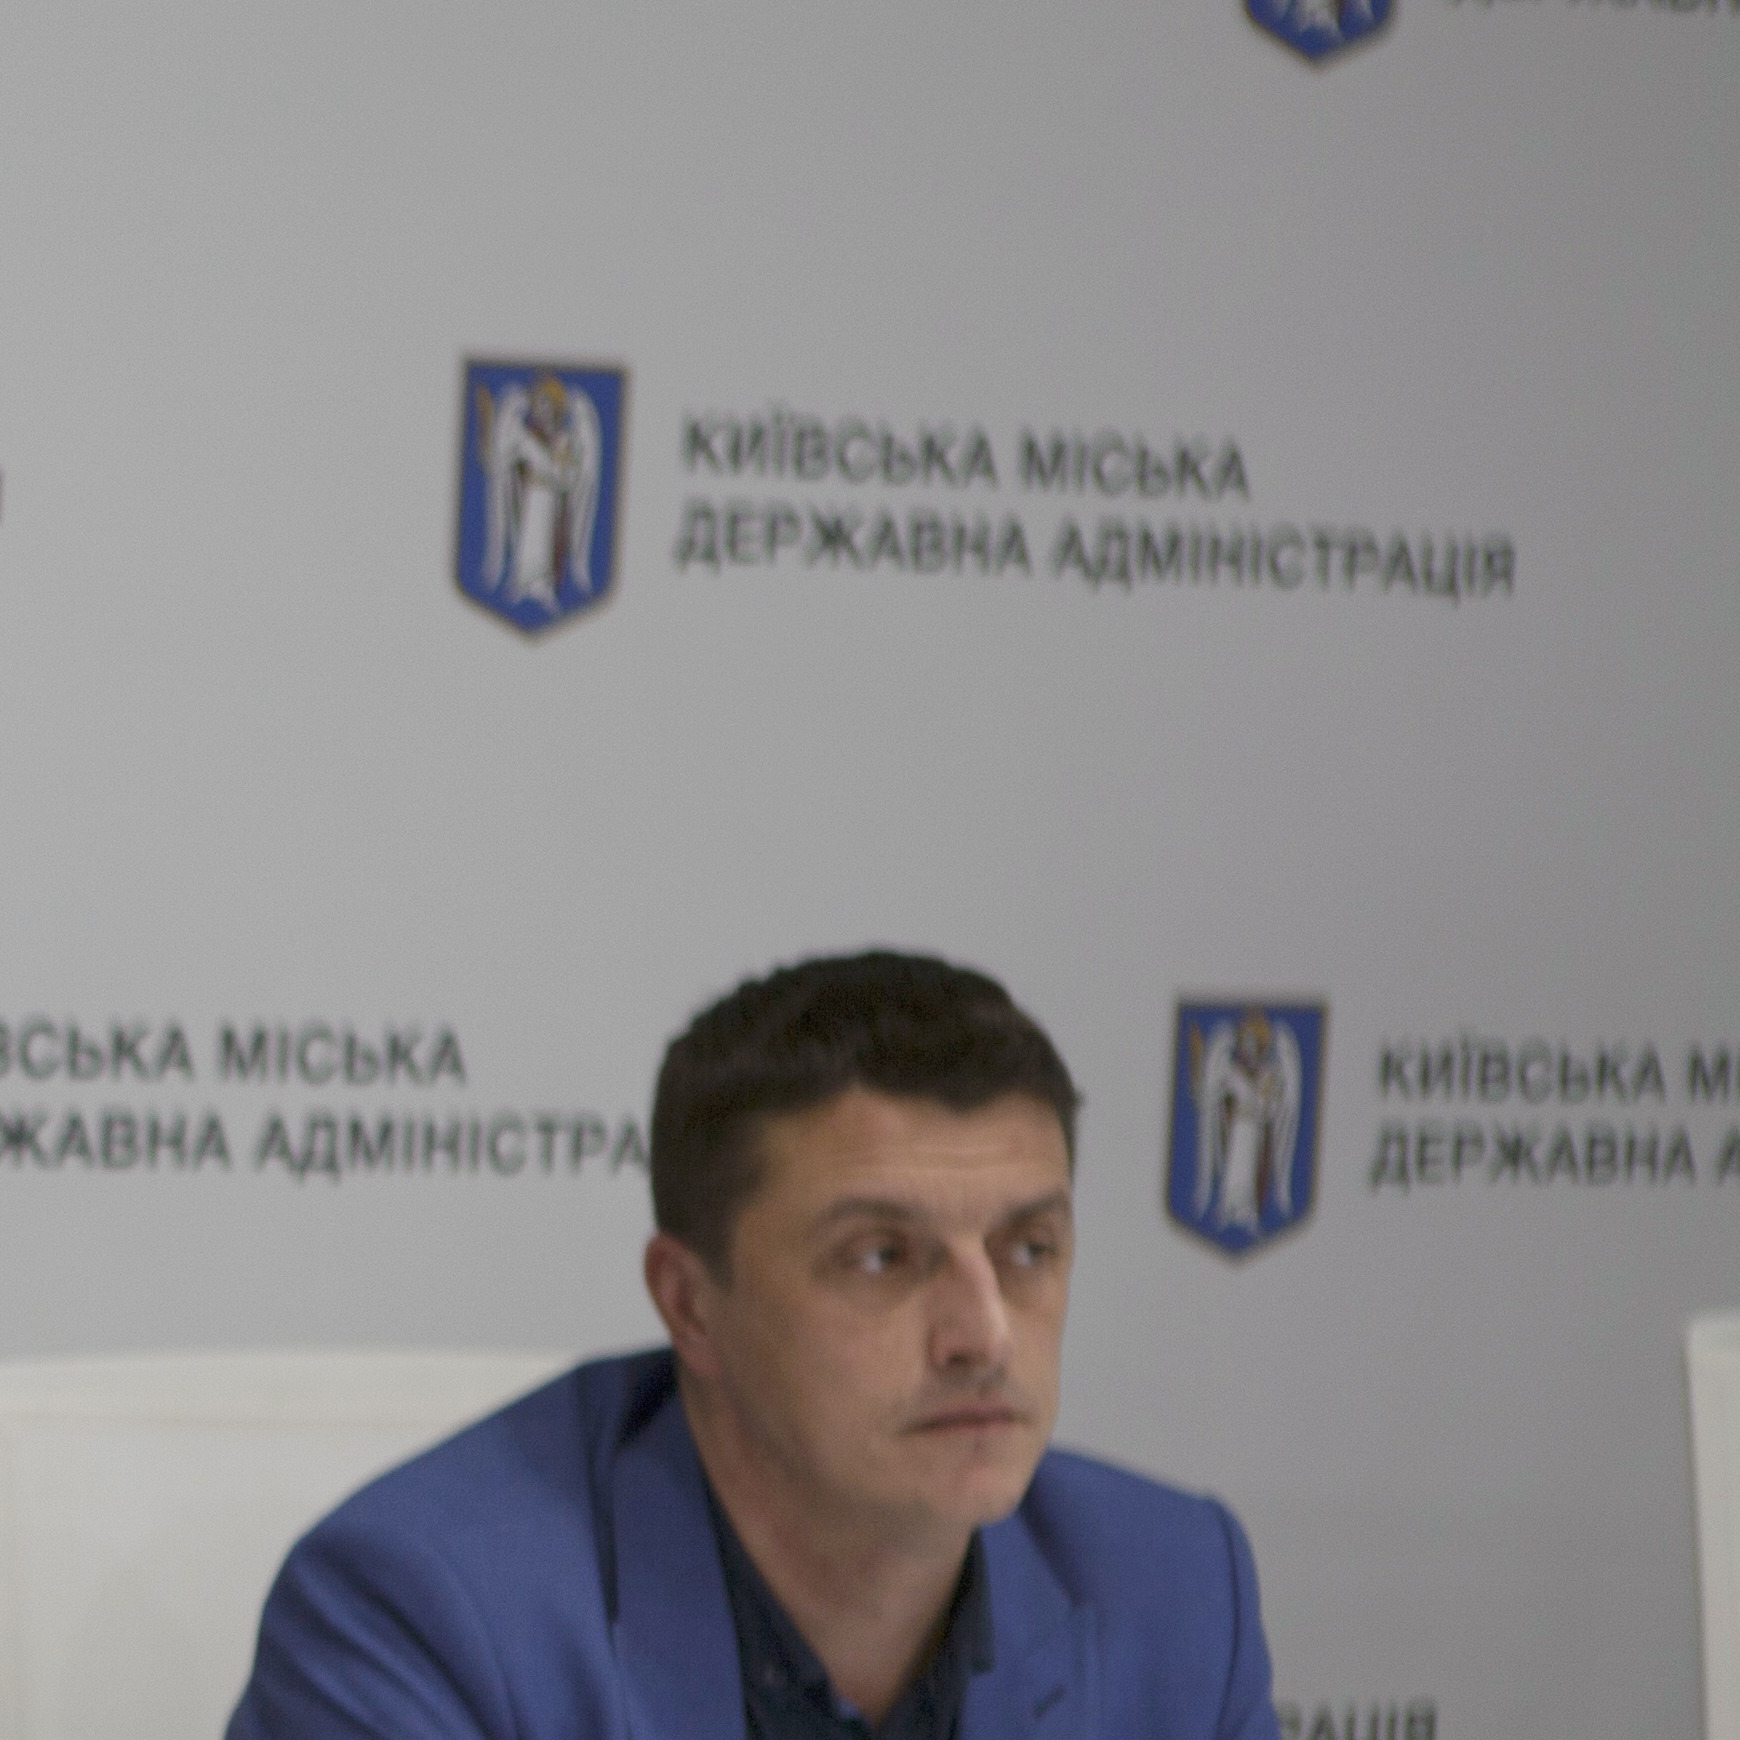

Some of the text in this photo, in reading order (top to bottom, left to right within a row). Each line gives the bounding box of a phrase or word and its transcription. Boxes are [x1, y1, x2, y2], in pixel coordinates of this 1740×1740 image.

[680, 405, 1251, 500] КИЇВСЬКА МІСЬКА
[672, 500, 1518, 607] ДЕРЖАВНА АДМІНІСТРАЦІЯ
[216, 1022, 468, 1088] МІСЬКА
[1376, 1030, 1667, 1104] КИЇВСЬКА
[1367, 1120, 1698, 1194] ДЕРЖАВНА
